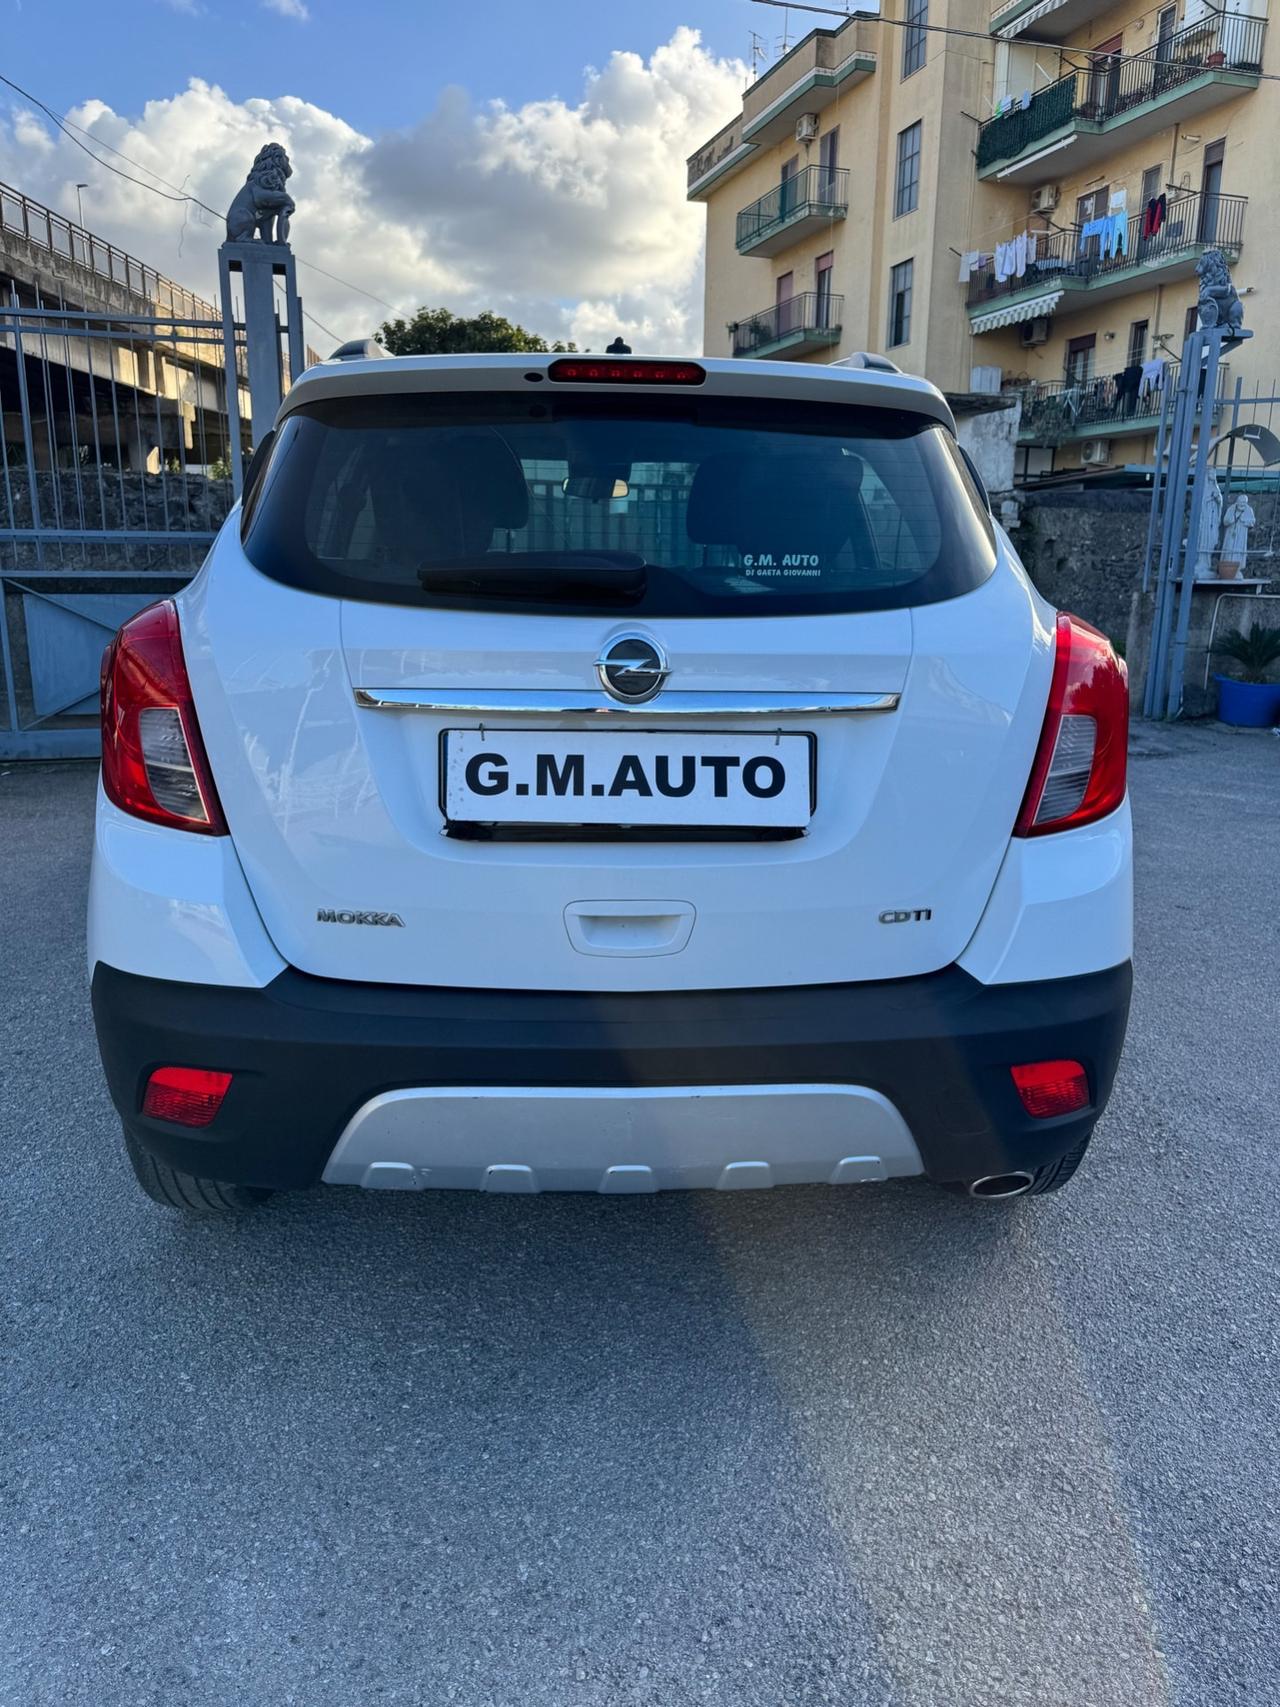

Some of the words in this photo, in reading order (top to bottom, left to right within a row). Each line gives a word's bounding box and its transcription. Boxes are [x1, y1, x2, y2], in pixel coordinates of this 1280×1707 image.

[743, 554, 777, 566] G.M.
[782, 554, 819, 566] AUTO
[783, 569, 821, 577] GIOVANNI
[465, 752, 786, 798] G.M.AUTO
[316, 908, 406, 928] MOKKA
[878, 908, 932, 924] CDTI
